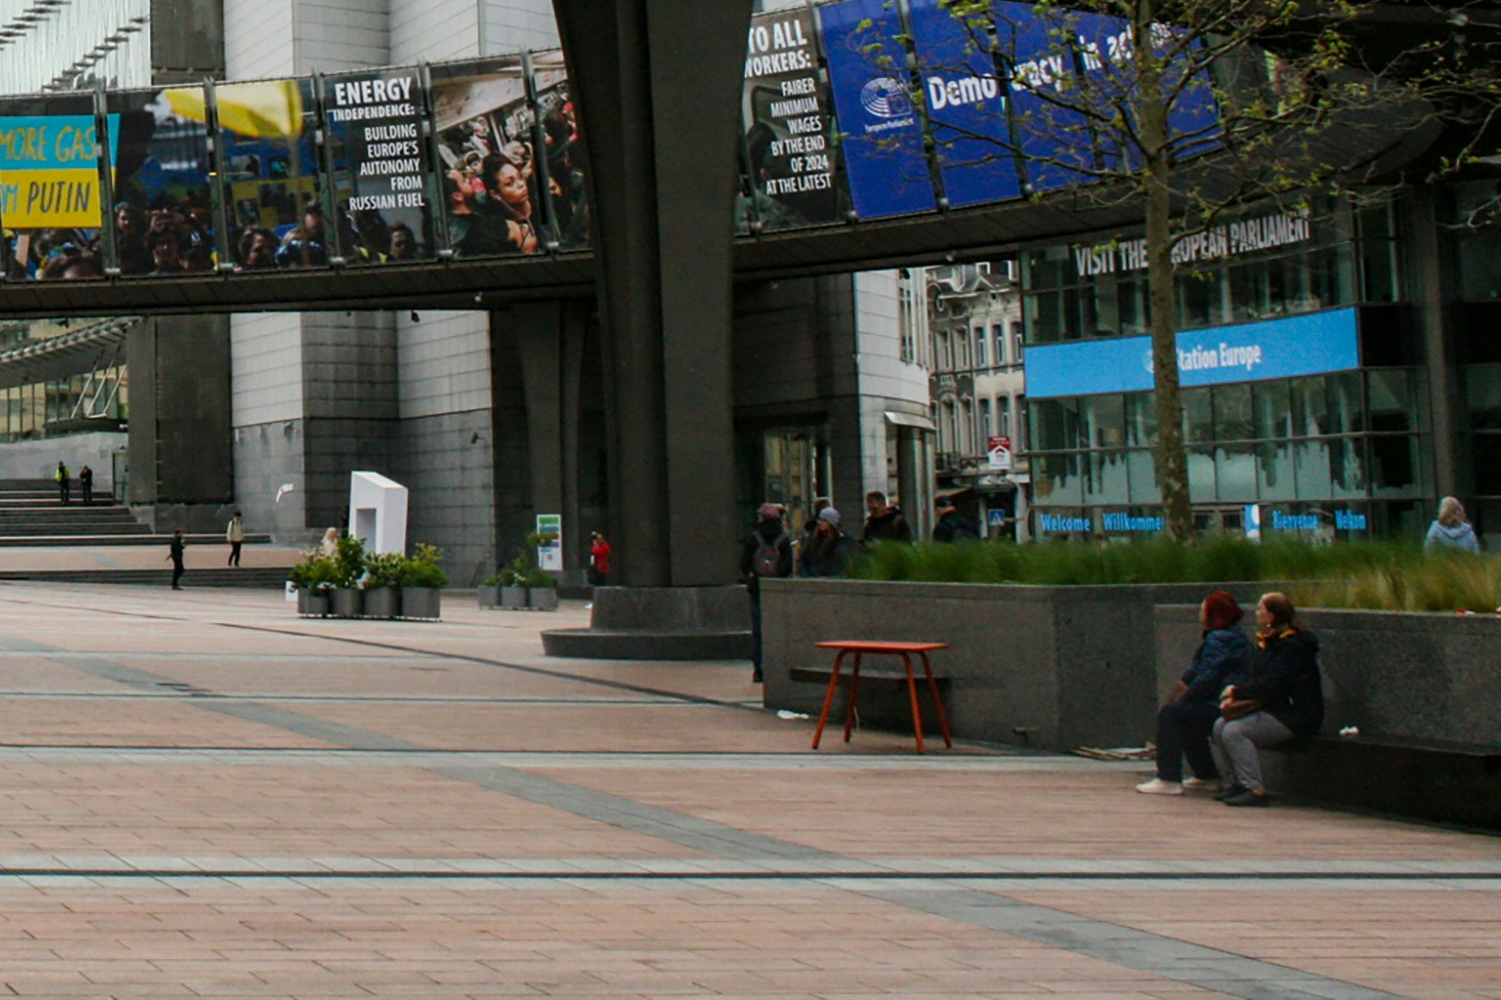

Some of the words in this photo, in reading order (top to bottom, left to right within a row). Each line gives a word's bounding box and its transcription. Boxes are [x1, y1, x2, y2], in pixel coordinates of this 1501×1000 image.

[773, 19, 808, 49] ALL
[1079, 34, 1102, 70] in
[334, 77, 412, 105] ENERGY
[781, 77, 816, 97] FAIRER
[333, 103, 415, 121] INDEPENDENCE:
[770, 97, 819, 118] MINIMUM
[364, 123, 417, 141] BUILDING
[787, 115, 822, 134] WAGES
[55, 125, 97, 162] GAS
[367, 141, 419, 158] EUROPE'S
[771, 140, 784, 157] BY
[785, 137, 804, 154] THE
[805, 135, 825, 151] END
[360, 158, 420, 176] AUTONOMY
[790, 157, 804, 173] OF
[805, 154, 829, 171] 2024
[390, 175, 423, 191] FROM
[766, 179, 778, 195] AT
[778, 176, 797, 194] THE
[798, 172, 832, 192] LATEST
[27, 181, 92, 215] PUTIN
[349, 195, 396, 211] RUSSIAN
[397, 193, 425, 208] FUEL
[1075, 245, 1115, 276] VISIT
[1119, 239, 1148, 271] THE
[1229, 208, 1310, 254] PARLIAMENT
[1177, 345, 1219, 371] tation
[1220, 342, 1262, 371] Europe
[1040, 513, 1091, 531] Welcome
